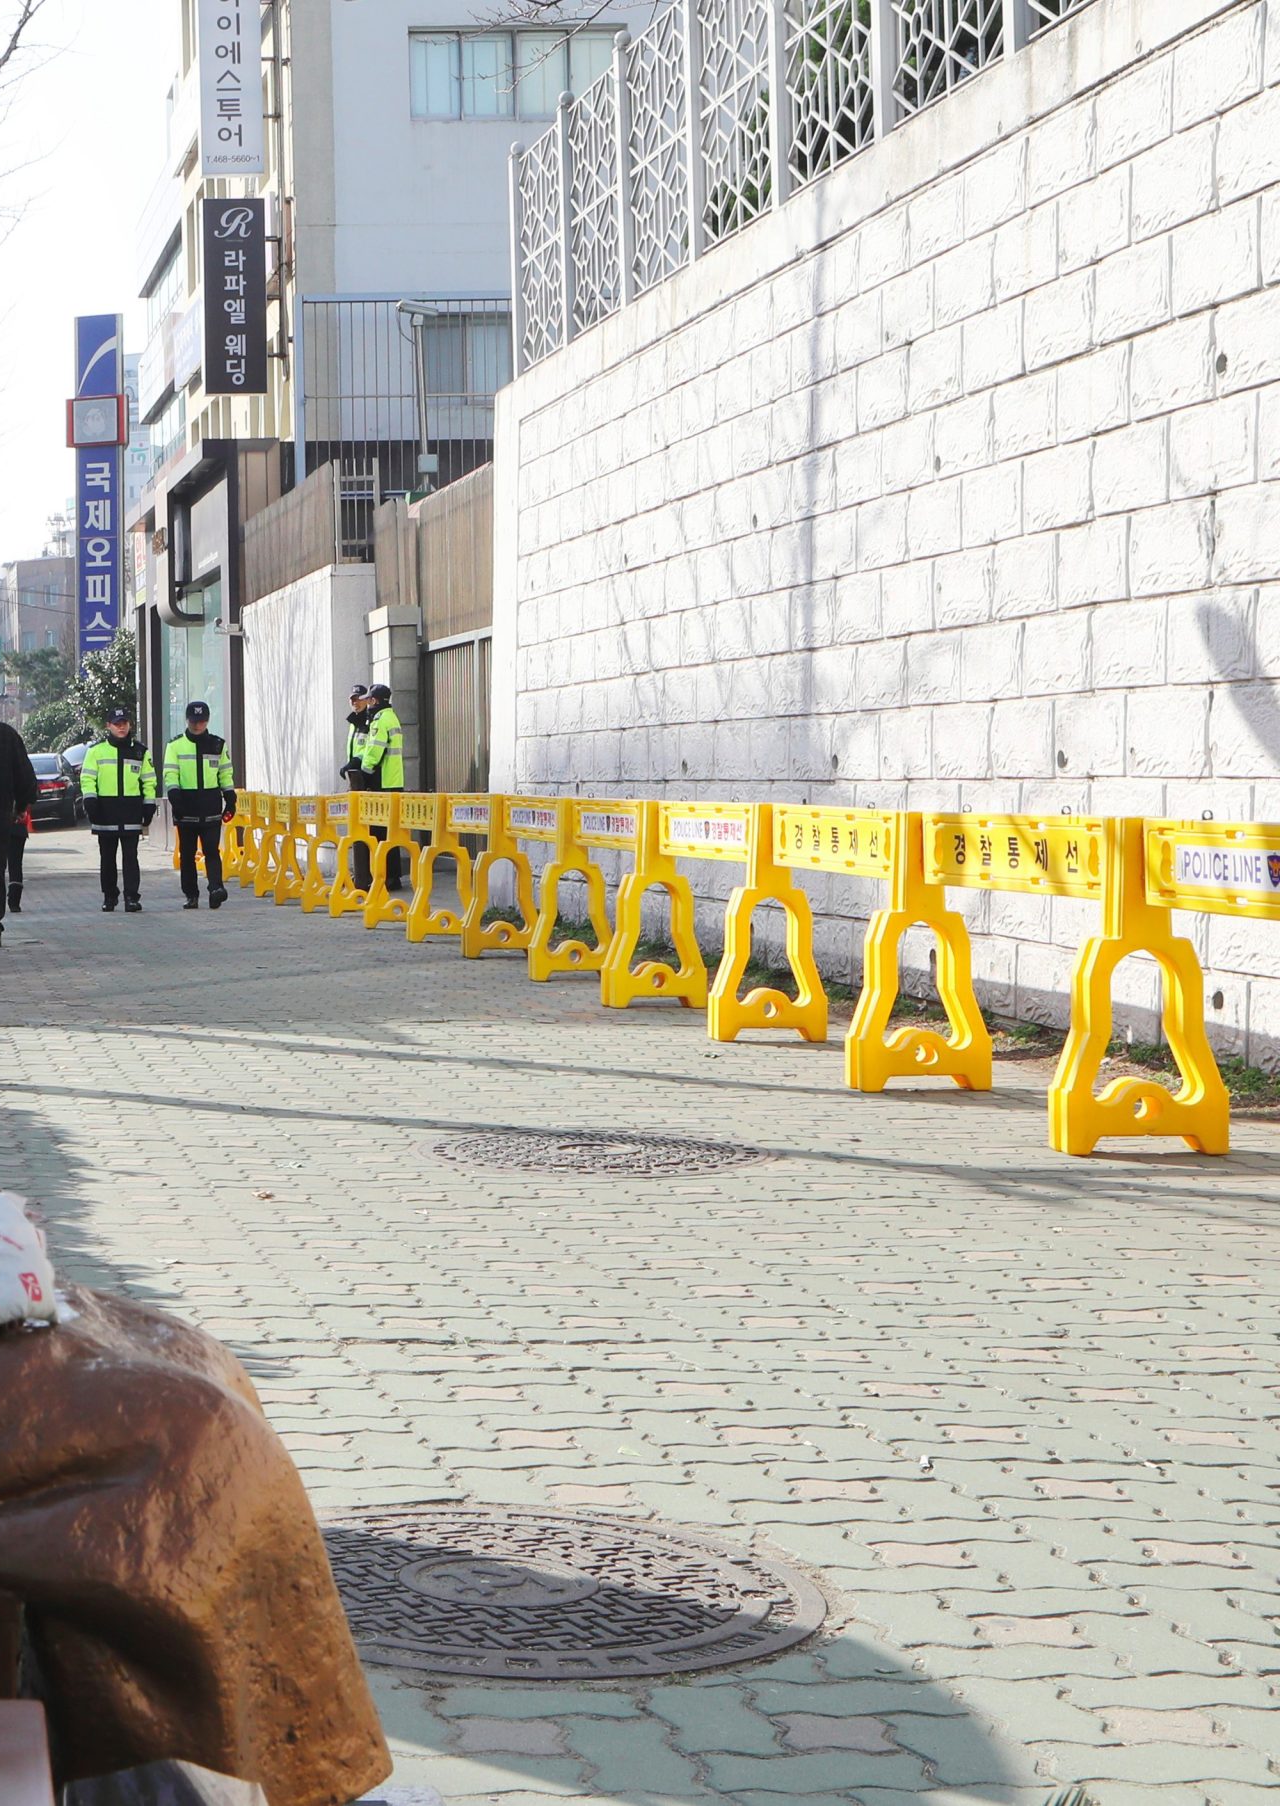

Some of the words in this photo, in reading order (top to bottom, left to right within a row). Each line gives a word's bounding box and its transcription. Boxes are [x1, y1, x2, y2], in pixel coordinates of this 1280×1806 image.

[214, 0, 243, 147] 이에스투어
[223, 249, 247, 325] 라파엘
[224, 333, 247, 386] 웨딩
[84, 462, 113, 659] 국제오피스
[794, 823, 878, 858] 경찰통제선
[953, 833, 1079, 873] 경찰통제선
[1183, 851, 1229, 881] POLICE
[1233, 853, 1262, 884] LINE
